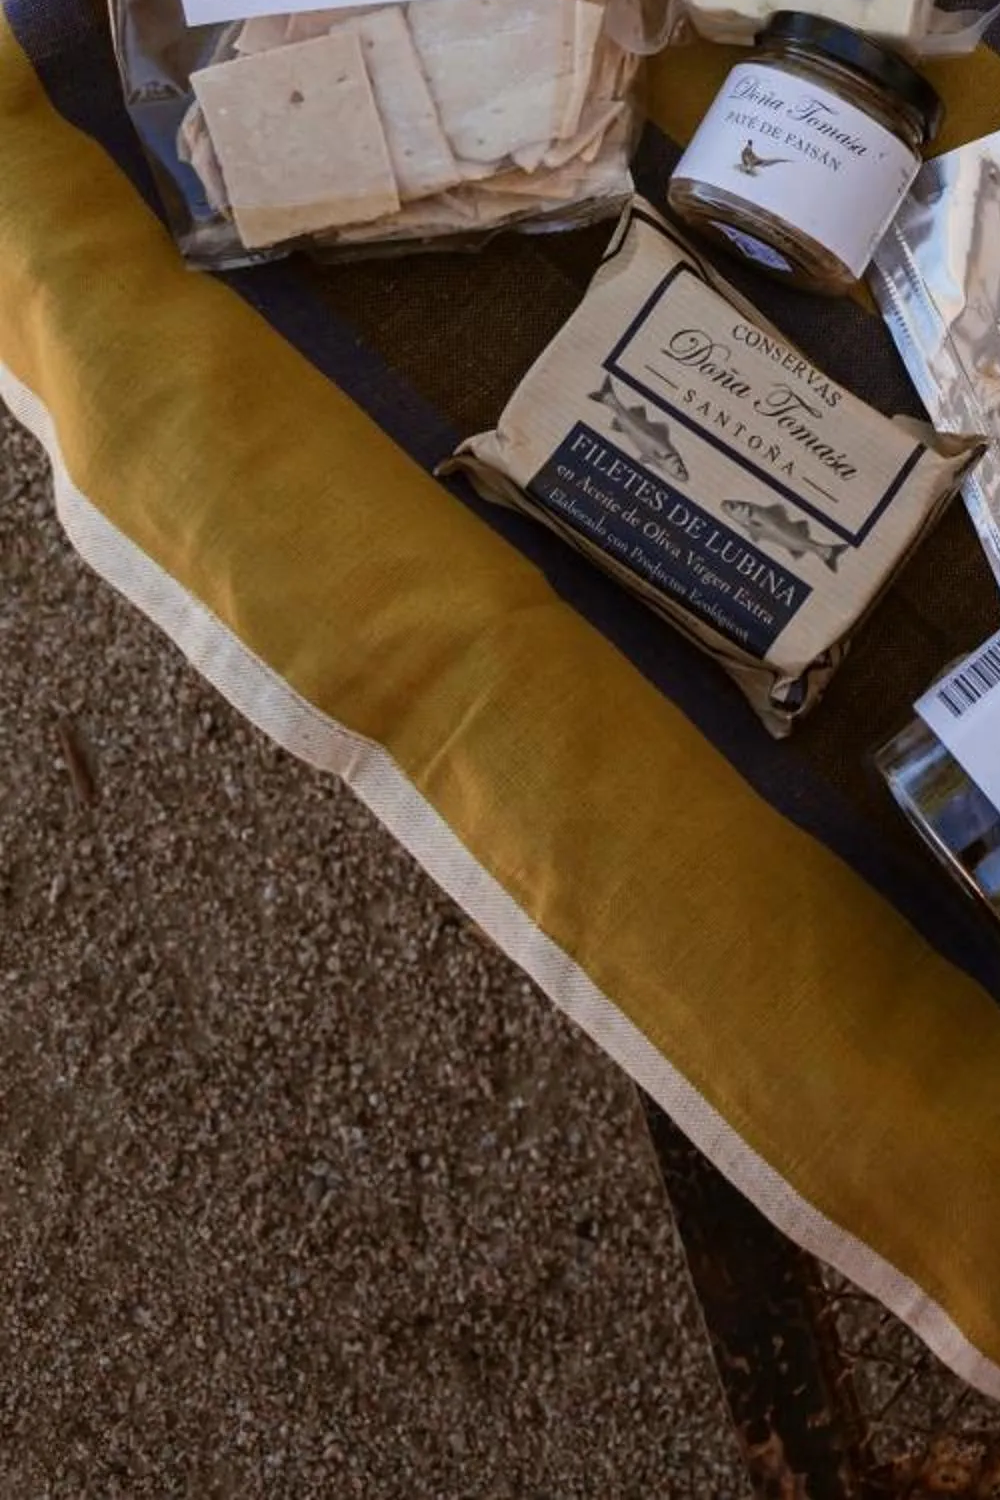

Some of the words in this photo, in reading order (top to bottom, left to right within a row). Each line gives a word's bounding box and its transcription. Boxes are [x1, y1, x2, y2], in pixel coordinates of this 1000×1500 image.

[758, 121, 782, 139] DE
[783, 132, 841, 171] FAISÁN
[786, 99, 867, 156] Tomasa
[661, 328, 751, 398] Doña
[753, 383, 856, 481] Tomasa
[731, 322, 843, 409] CONSERVAS
[682, 388, 794, 476] SANTOÑA
[548, 487, 606, 535] Elaborado
[606, 533, 628, 553] con
[556, 464, 575, 480] en
[575, 475, 620, 512] Aceite
[620, 507, 640, 527] de
[642, 521, 681, 558] Oliva
[686, 549, 731, 593] Virgen
[732, 586, 773, 625] Extra
[570, 433, 668, 511] FILETES
[666, 503, 707, 539] DE
[704, 530, 795, 606] LUBINA
